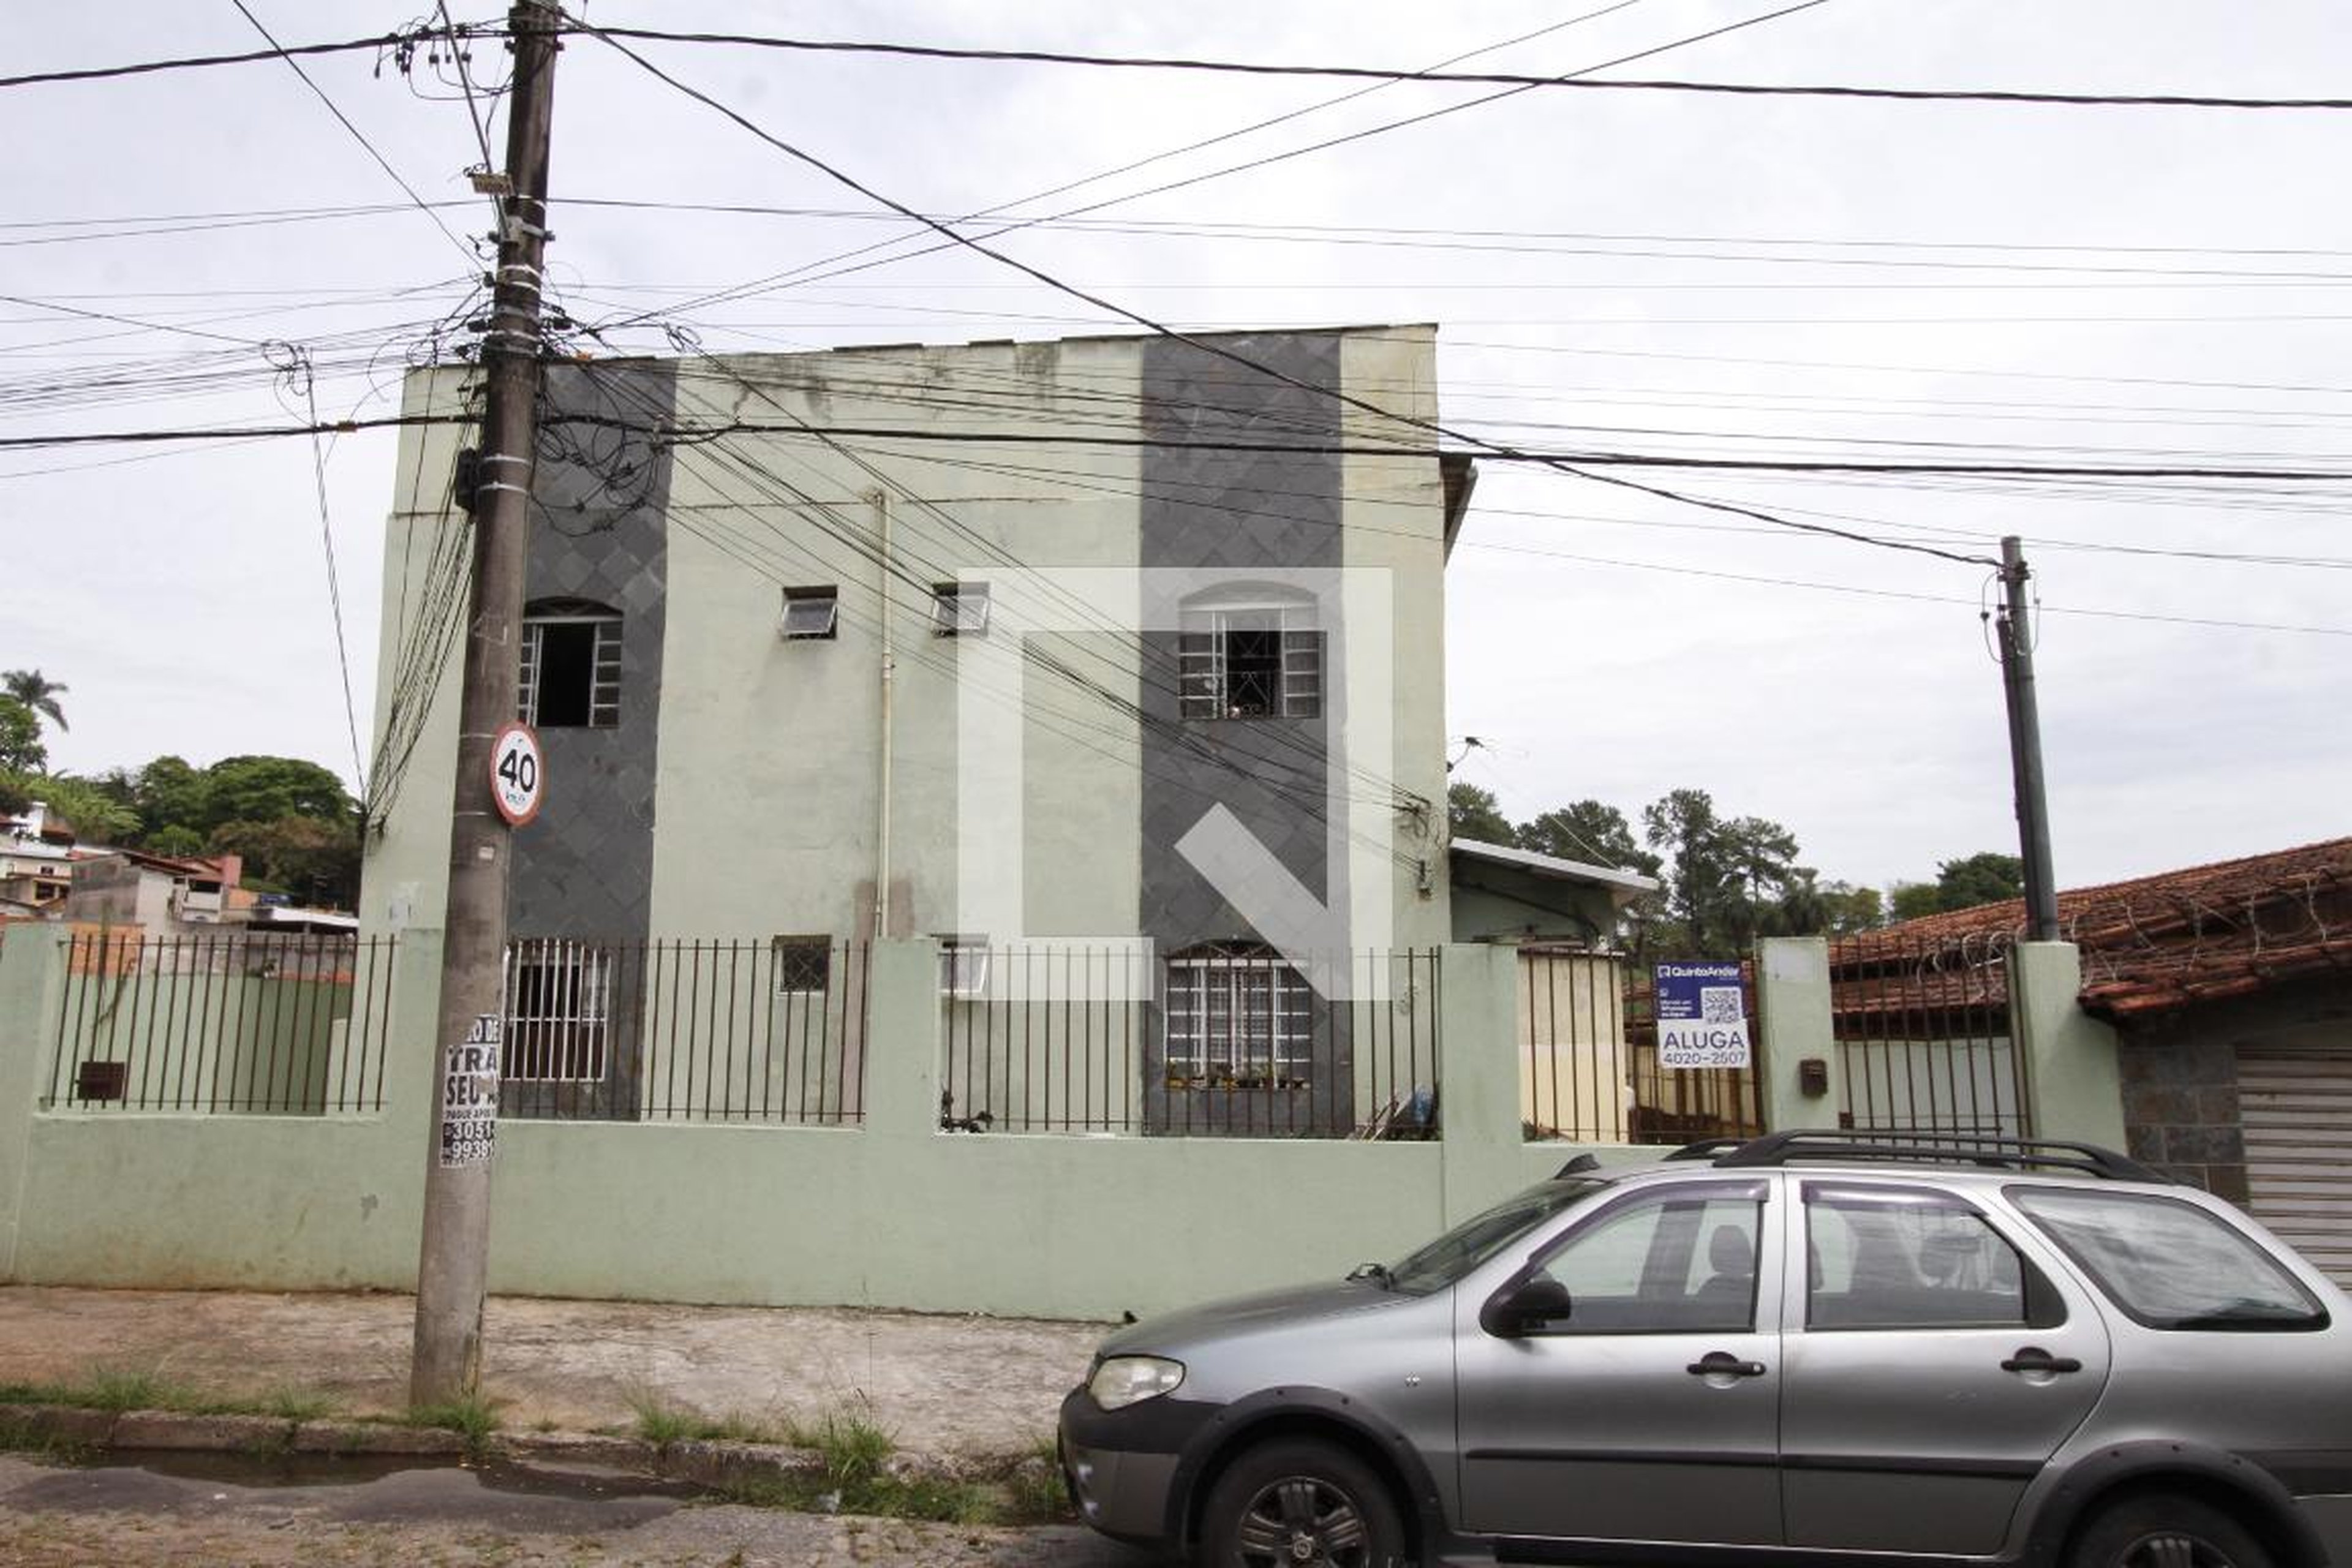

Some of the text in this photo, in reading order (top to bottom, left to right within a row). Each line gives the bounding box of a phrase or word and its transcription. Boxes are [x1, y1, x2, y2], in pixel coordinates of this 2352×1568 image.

[499, 748, 536, 793] 40
[1672, 965, 1739, 977] QuintoAndar
[1664, 1031, 1745, 1049] ALUGA
[1664, 1052, 1745, 1065] 4020-2507
